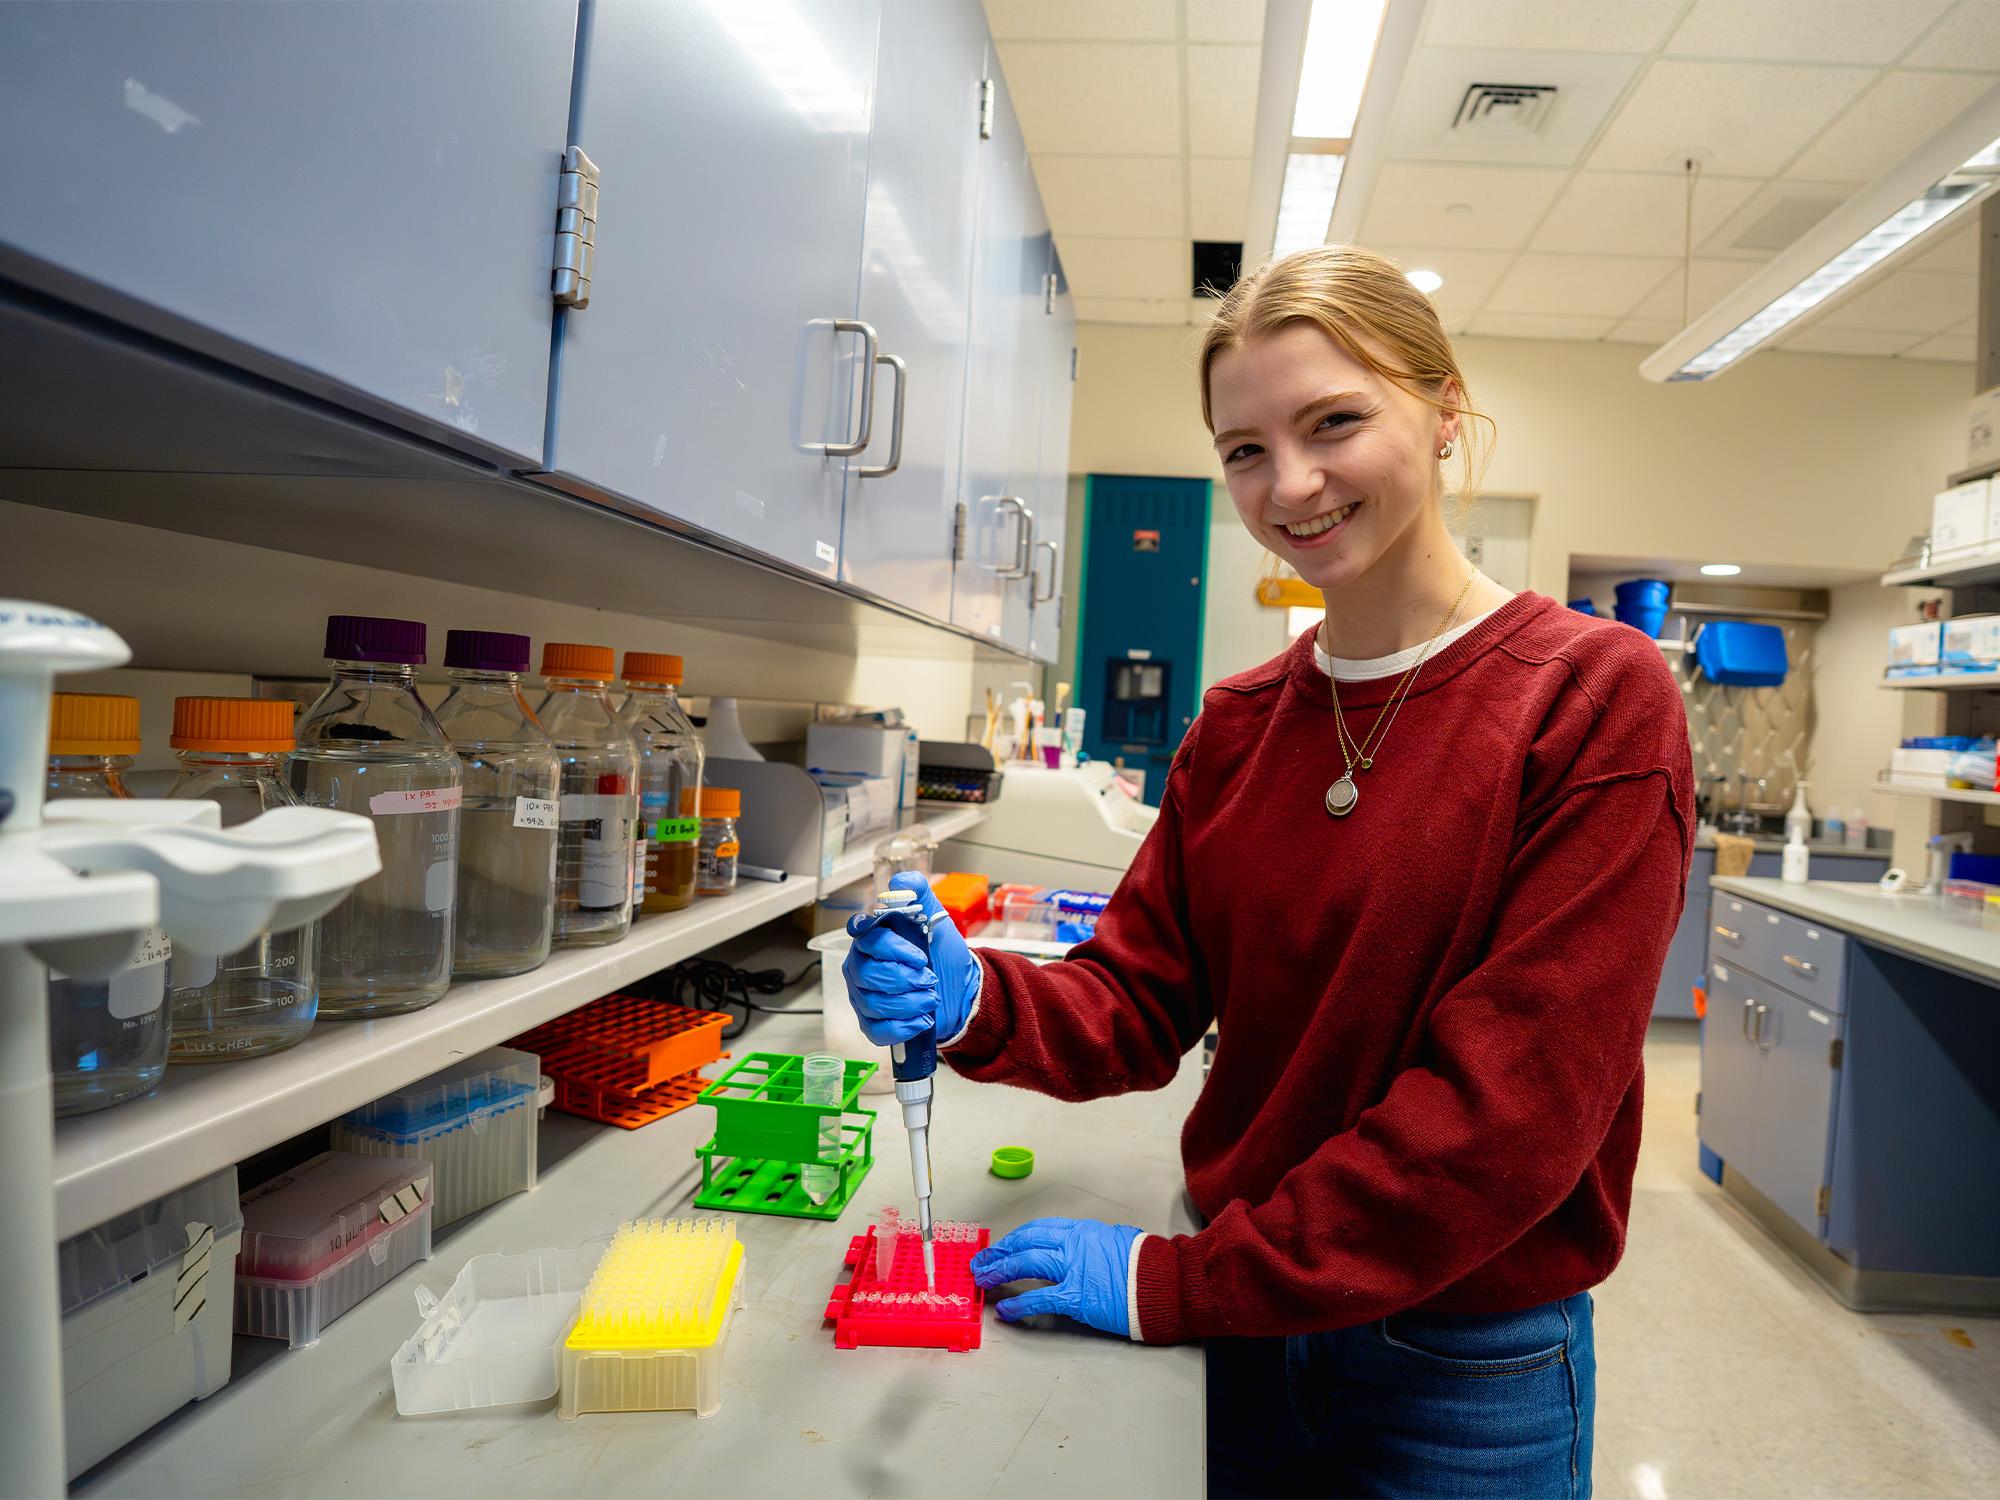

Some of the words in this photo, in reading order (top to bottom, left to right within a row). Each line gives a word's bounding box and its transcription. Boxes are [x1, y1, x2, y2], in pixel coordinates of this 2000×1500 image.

[420, 790, 436, 800] PBS
[275, 956, 295, 968] 200
[277, 995, 294, 1007] 100
[123, 1020, 138, 1030] No.
[140, 1014, 157, 1025] 1395
[329, 1235, 342, 1253] 10
